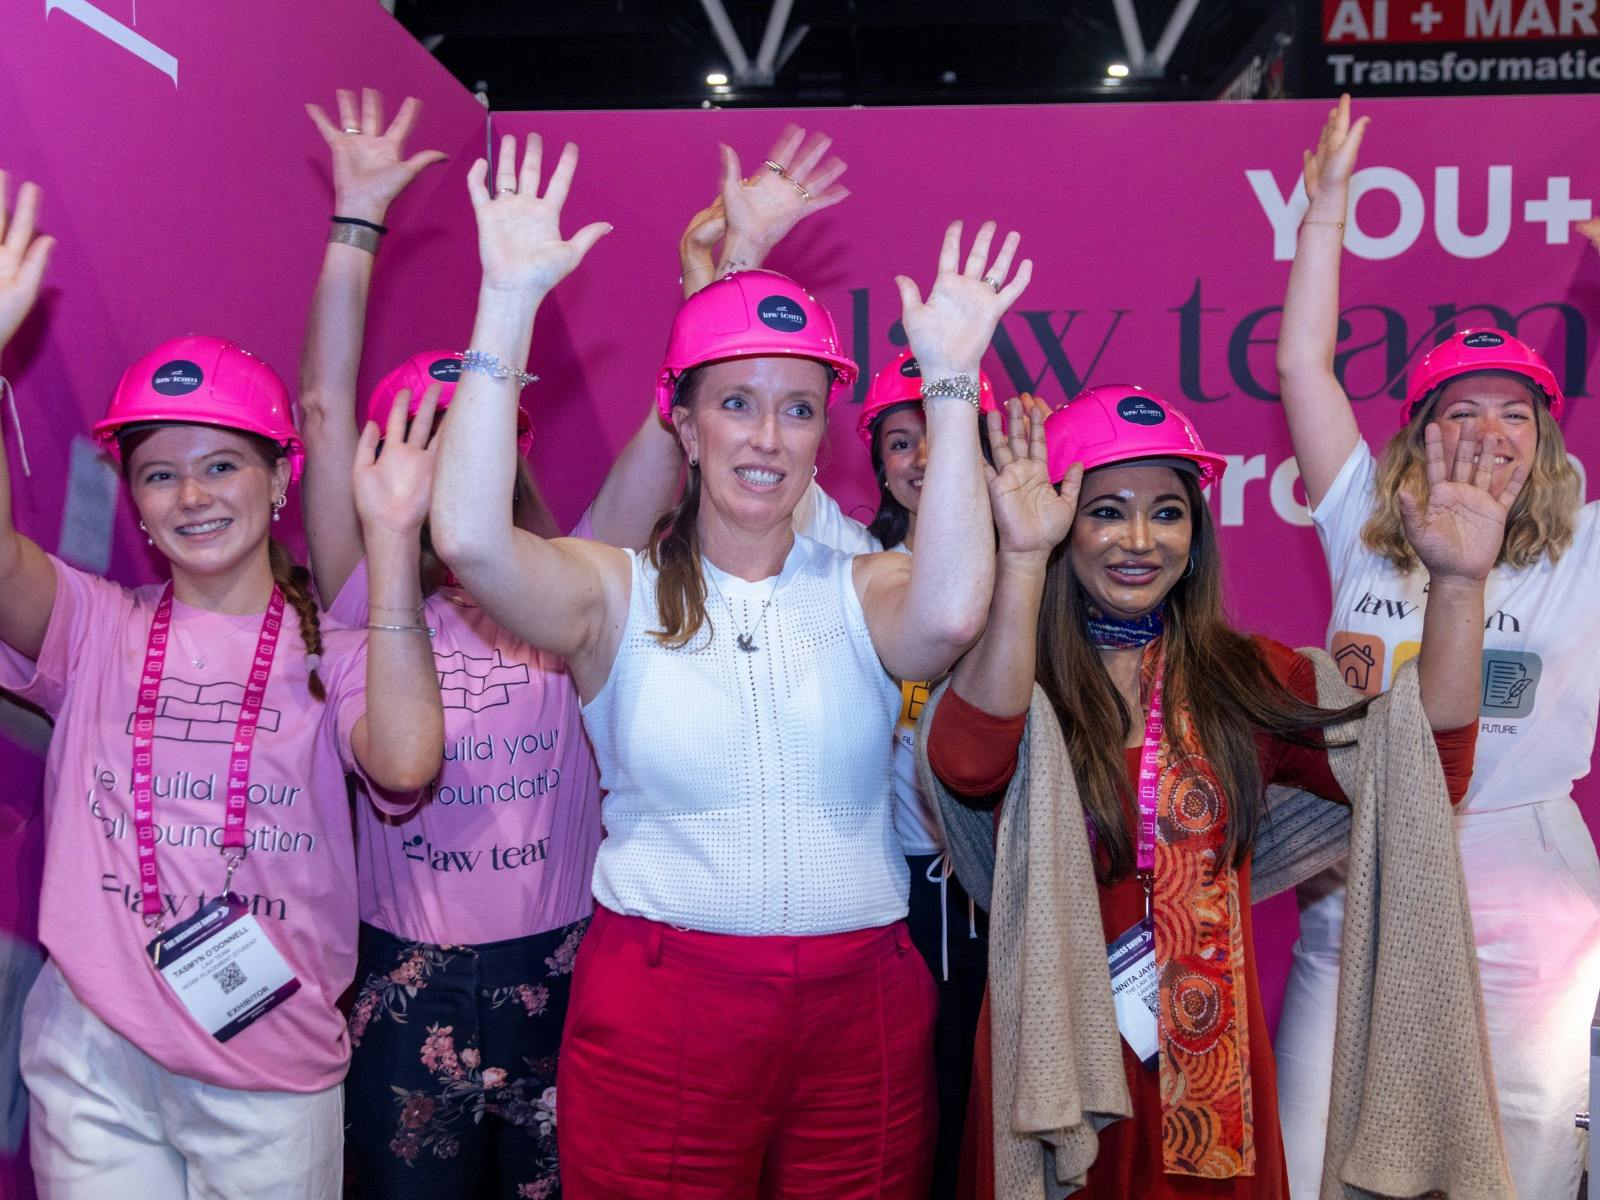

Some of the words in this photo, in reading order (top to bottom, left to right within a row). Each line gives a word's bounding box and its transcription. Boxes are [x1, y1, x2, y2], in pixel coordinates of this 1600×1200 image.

[1326, 0, 1389, 41] AI
[848, 287, 1134, 406] lw
[1353, 592, 1419, 620] law
[1481, 724, 1518, 735] FUTURE
[441, 734, 495, 761] uild
[130, 767, 216, 802] uild
[245, 783, 302, 807] our
[172, 953, 206, 978] TASMYN
[203, 924, 250, 958] O'DONNELL
[1125, 934, 1144, 950] SHOW
[226, 985, 270, 1017] EXHIBITOR
